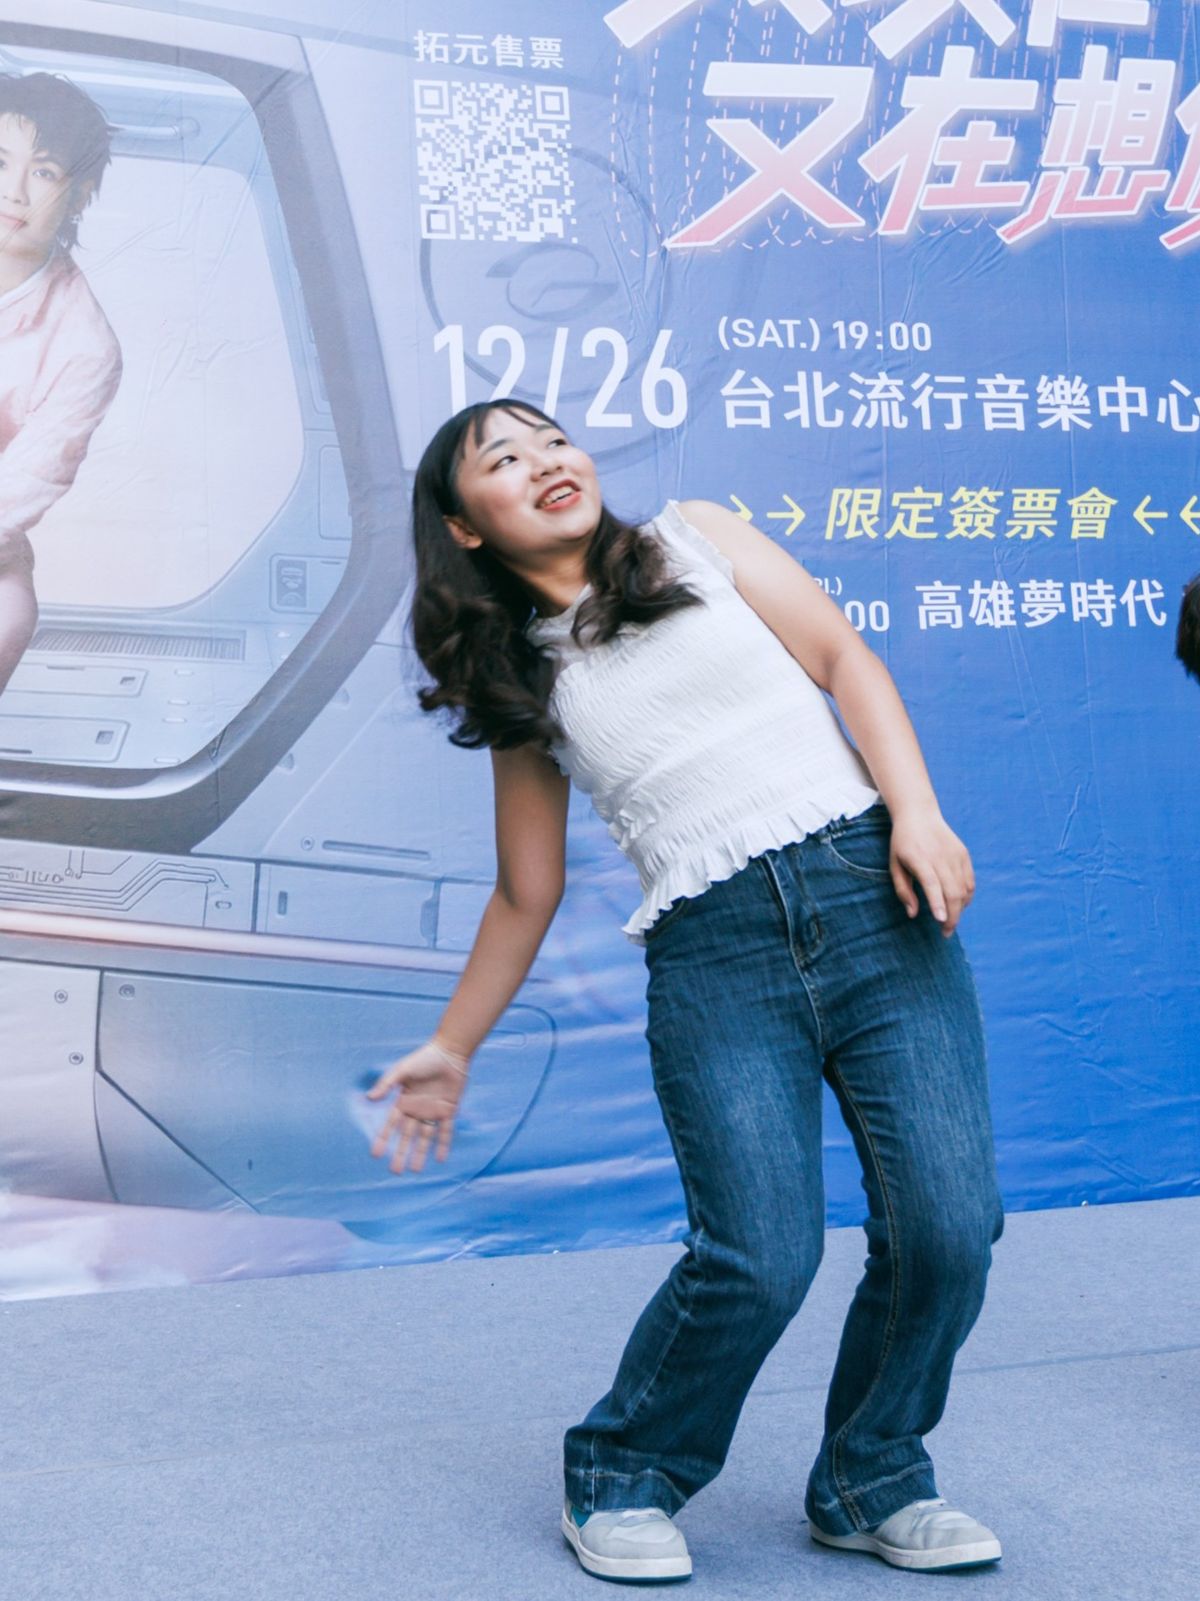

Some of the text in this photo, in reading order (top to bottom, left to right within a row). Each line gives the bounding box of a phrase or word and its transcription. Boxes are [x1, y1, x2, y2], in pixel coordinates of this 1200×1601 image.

[414, 30, 564, 70] 拓元售票
[717, 316, 932, 353] (SAT.) 19:00
[433, 324, 688, 429] 12/26
[825, 486, 1119, 541] 限定簽票會
[915, 578, 1168, 630] 高雄夢時代
